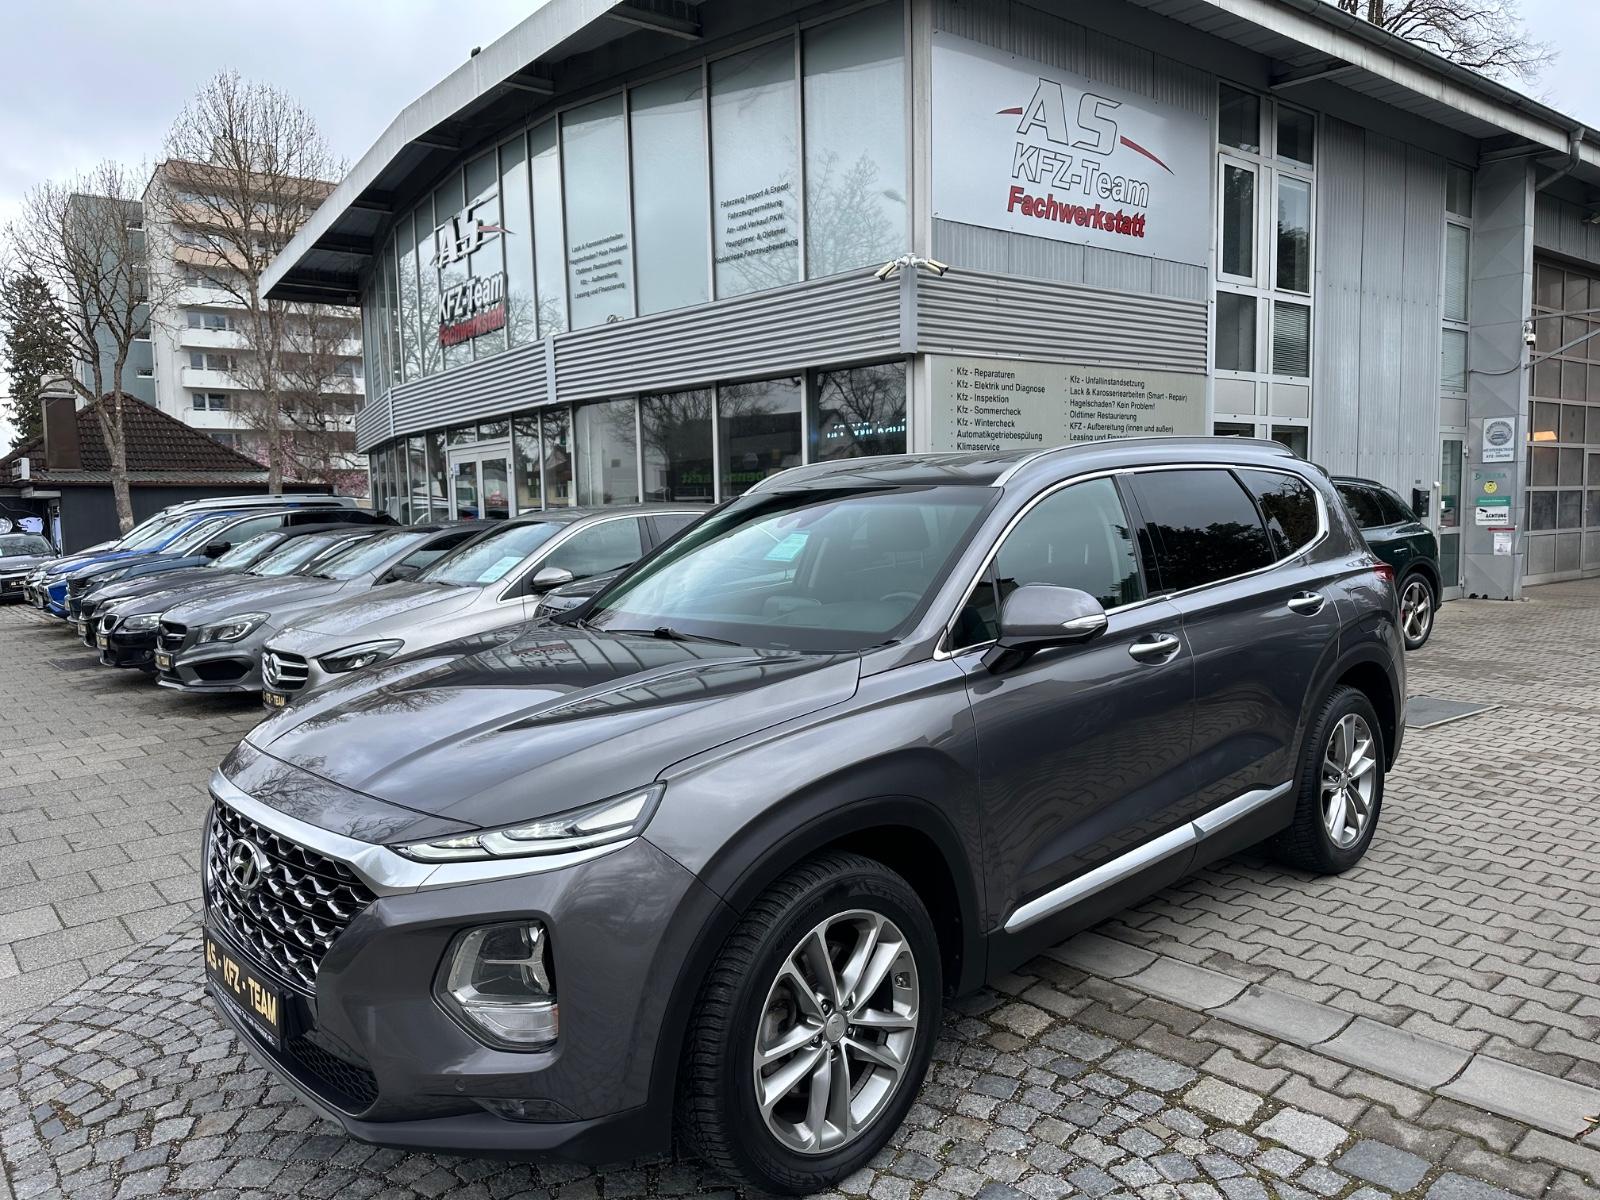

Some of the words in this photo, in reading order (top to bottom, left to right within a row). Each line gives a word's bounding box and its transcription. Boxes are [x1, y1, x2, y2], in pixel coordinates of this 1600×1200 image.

[1017, 77, 1122, 156] AS
[1011, 141, 1150, 208] KFZ-Team
[1007, 185, 1145, 238] Fachwerkstatt
[438, 198, 484, 269] AS
[438, 270, 505, 323] KFZ-Team
[439, 303, 506, 347] Fachwerkstatt
[957, 367, 968, 376] Kfz
[974, 368, 1015, 379] Reparaturen
[1070, 375, 1080, 383] Kfz
[957, 380, 968, 389] Kfz
[974, 381, 1000, 391] Elektrik
[1001, 383, 1014, 392] und
[1015, 384, 1045, 394] Diagnose
[1070, 388, 1085, 396] Lack
[1086, 388, 1091, 396] &
[957, 393, 968, 401] Kfz
[974, 393, 1009, 404] Inspektion
[1070, 399, 1115, 409] Hagelschaden?
[1117, 401, 1130, 409] Kein
[957, 405, 968, 414] Kfz
[974, 406, 1021, 416] Sommercheck
[1070, 410, 1096, 419] Oldtimer
[957, 418, 968, 426] Kfz
[974, 418, 1015, 428] Wintercheck
[1070, 422, 1082, 430] KFZ
[1087, 423, 1124, 433] Aufbereitung
[1144, 424, 1154, 432] und
[957, 430, 1043, 441] Automatikgetriebespülung
[957, 442, 1000, 451] Klimaservice
[223, 954, 240, 994] KFZ
[247, 976, 277, 1026] TEAM
